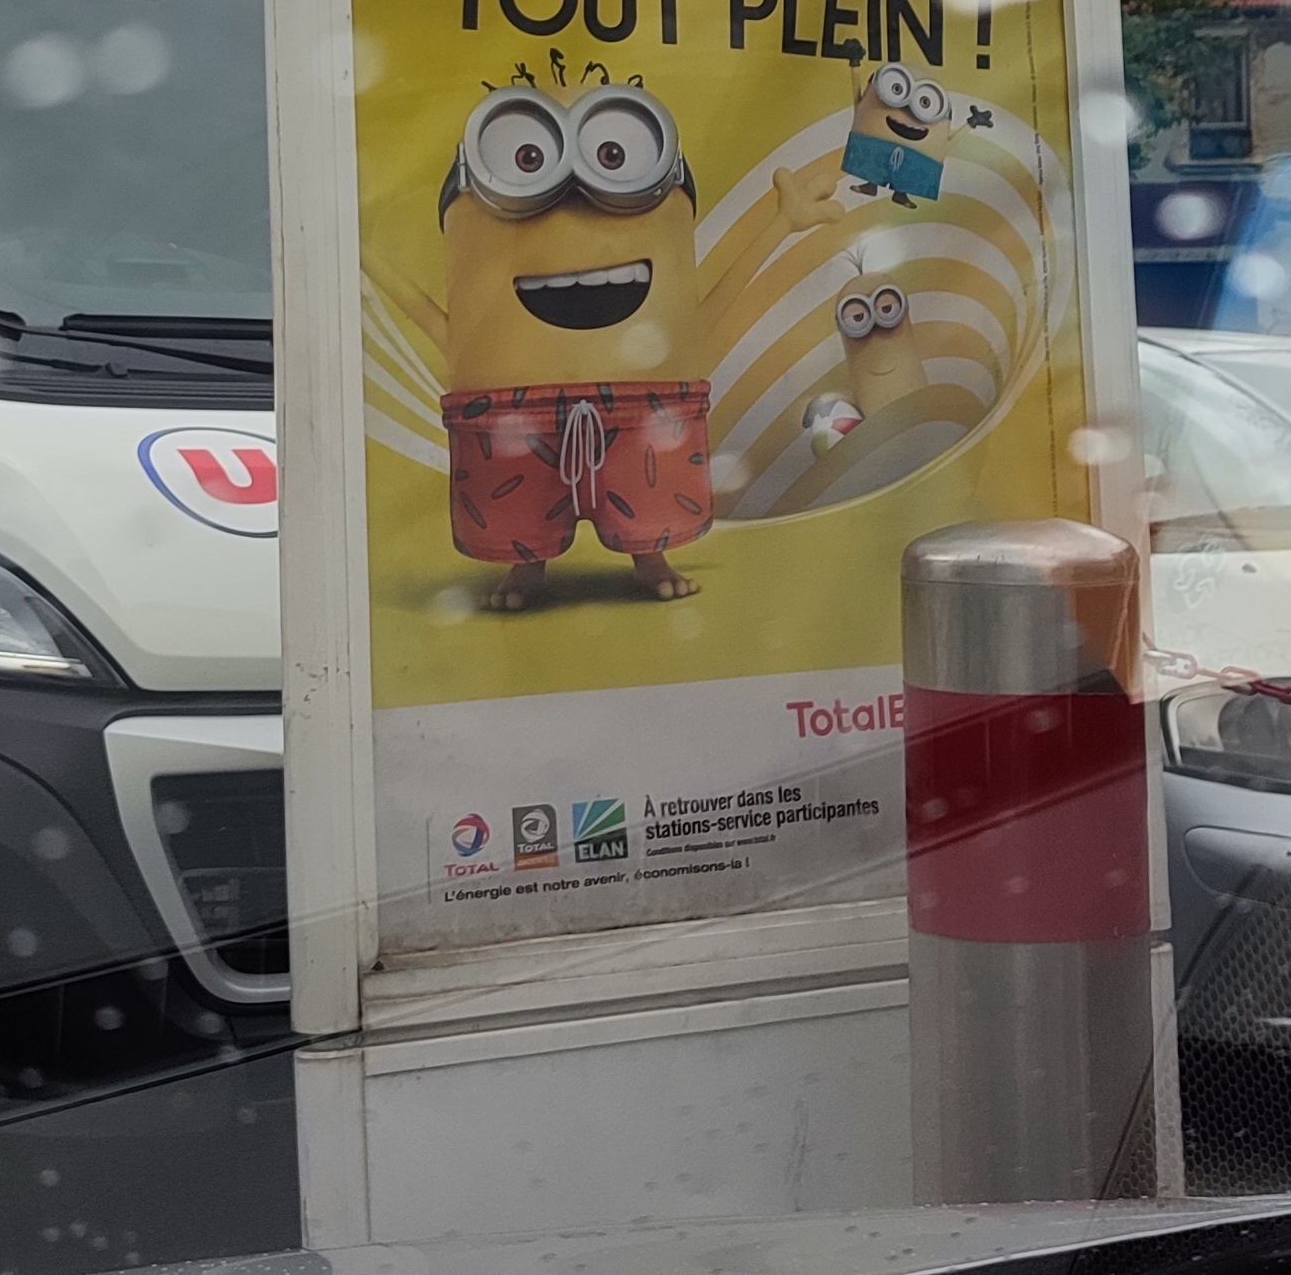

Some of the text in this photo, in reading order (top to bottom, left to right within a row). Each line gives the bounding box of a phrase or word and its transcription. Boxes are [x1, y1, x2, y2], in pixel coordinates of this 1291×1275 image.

[175, 448, 278, 505] U
[643, 785, 802, 819] À retrouver dans les
[645, 797, 880, 840] stations-service participantes
[516, 842, 556, 853] TOTAL
[578, 840, 626, 861] ELAN
[444, 861, 501, 877] TOTAL
[445, 884, 512, 903] L'énergie
[516, 882, 539, 895] est
[543, 878, 580, 892] notre
[583, 872, 630, 887] avenir,
[633, 857, 743, 881] économisons-la
